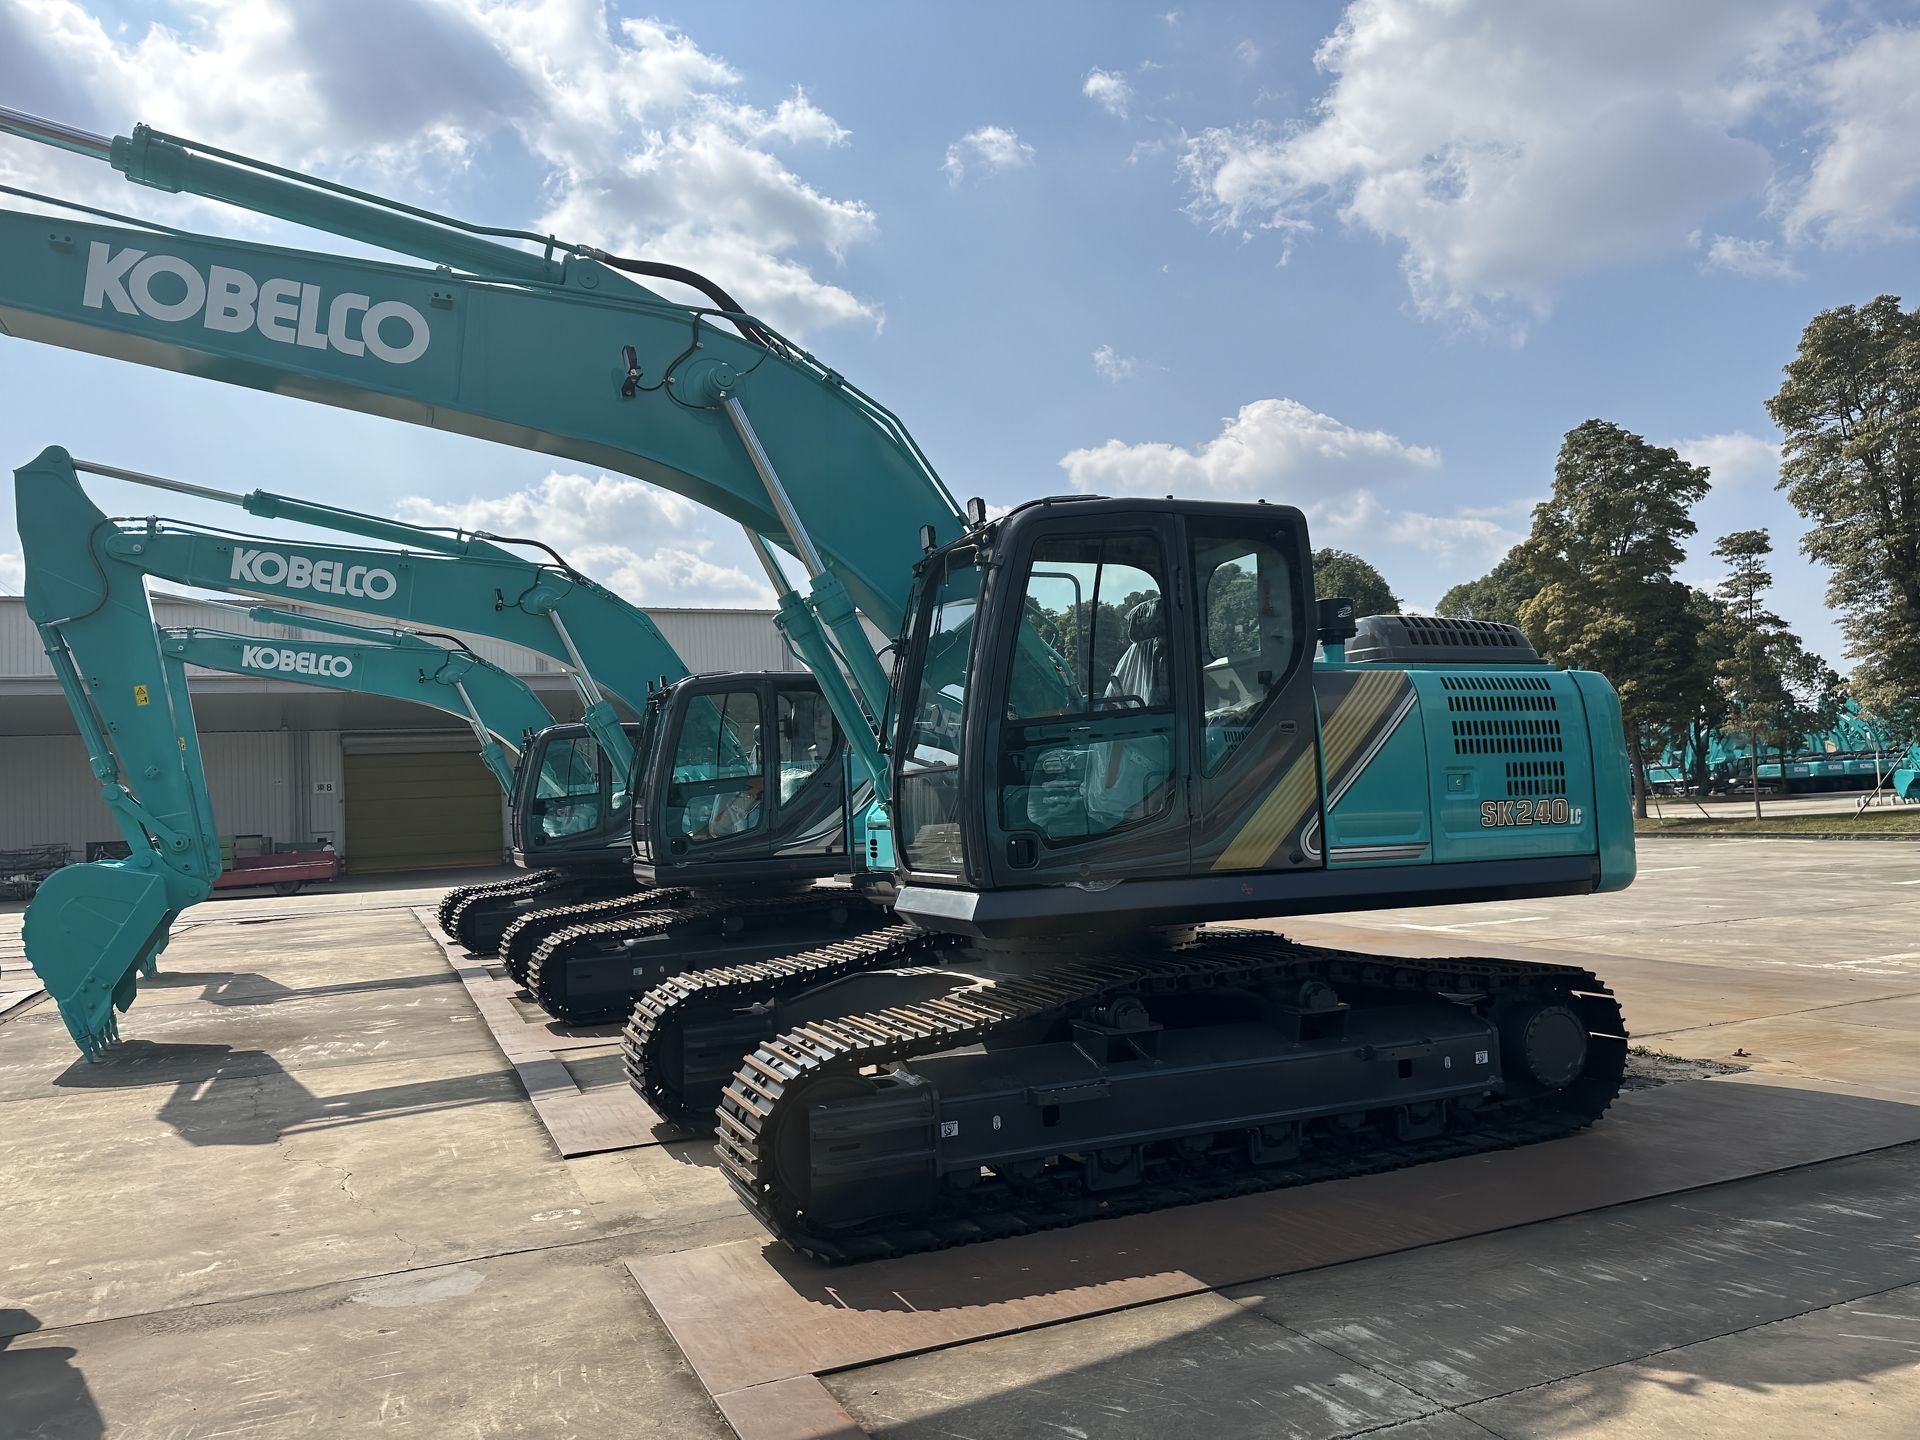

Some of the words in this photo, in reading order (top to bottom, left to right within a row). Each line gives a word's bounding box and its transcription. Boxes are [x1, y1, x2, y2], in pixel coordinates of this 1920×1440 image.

[82, 240, 431, 365] KOBELCO
[230, 546, 397, 600] KOBELCO
[241, 645, 353, 678] KOBELCO
